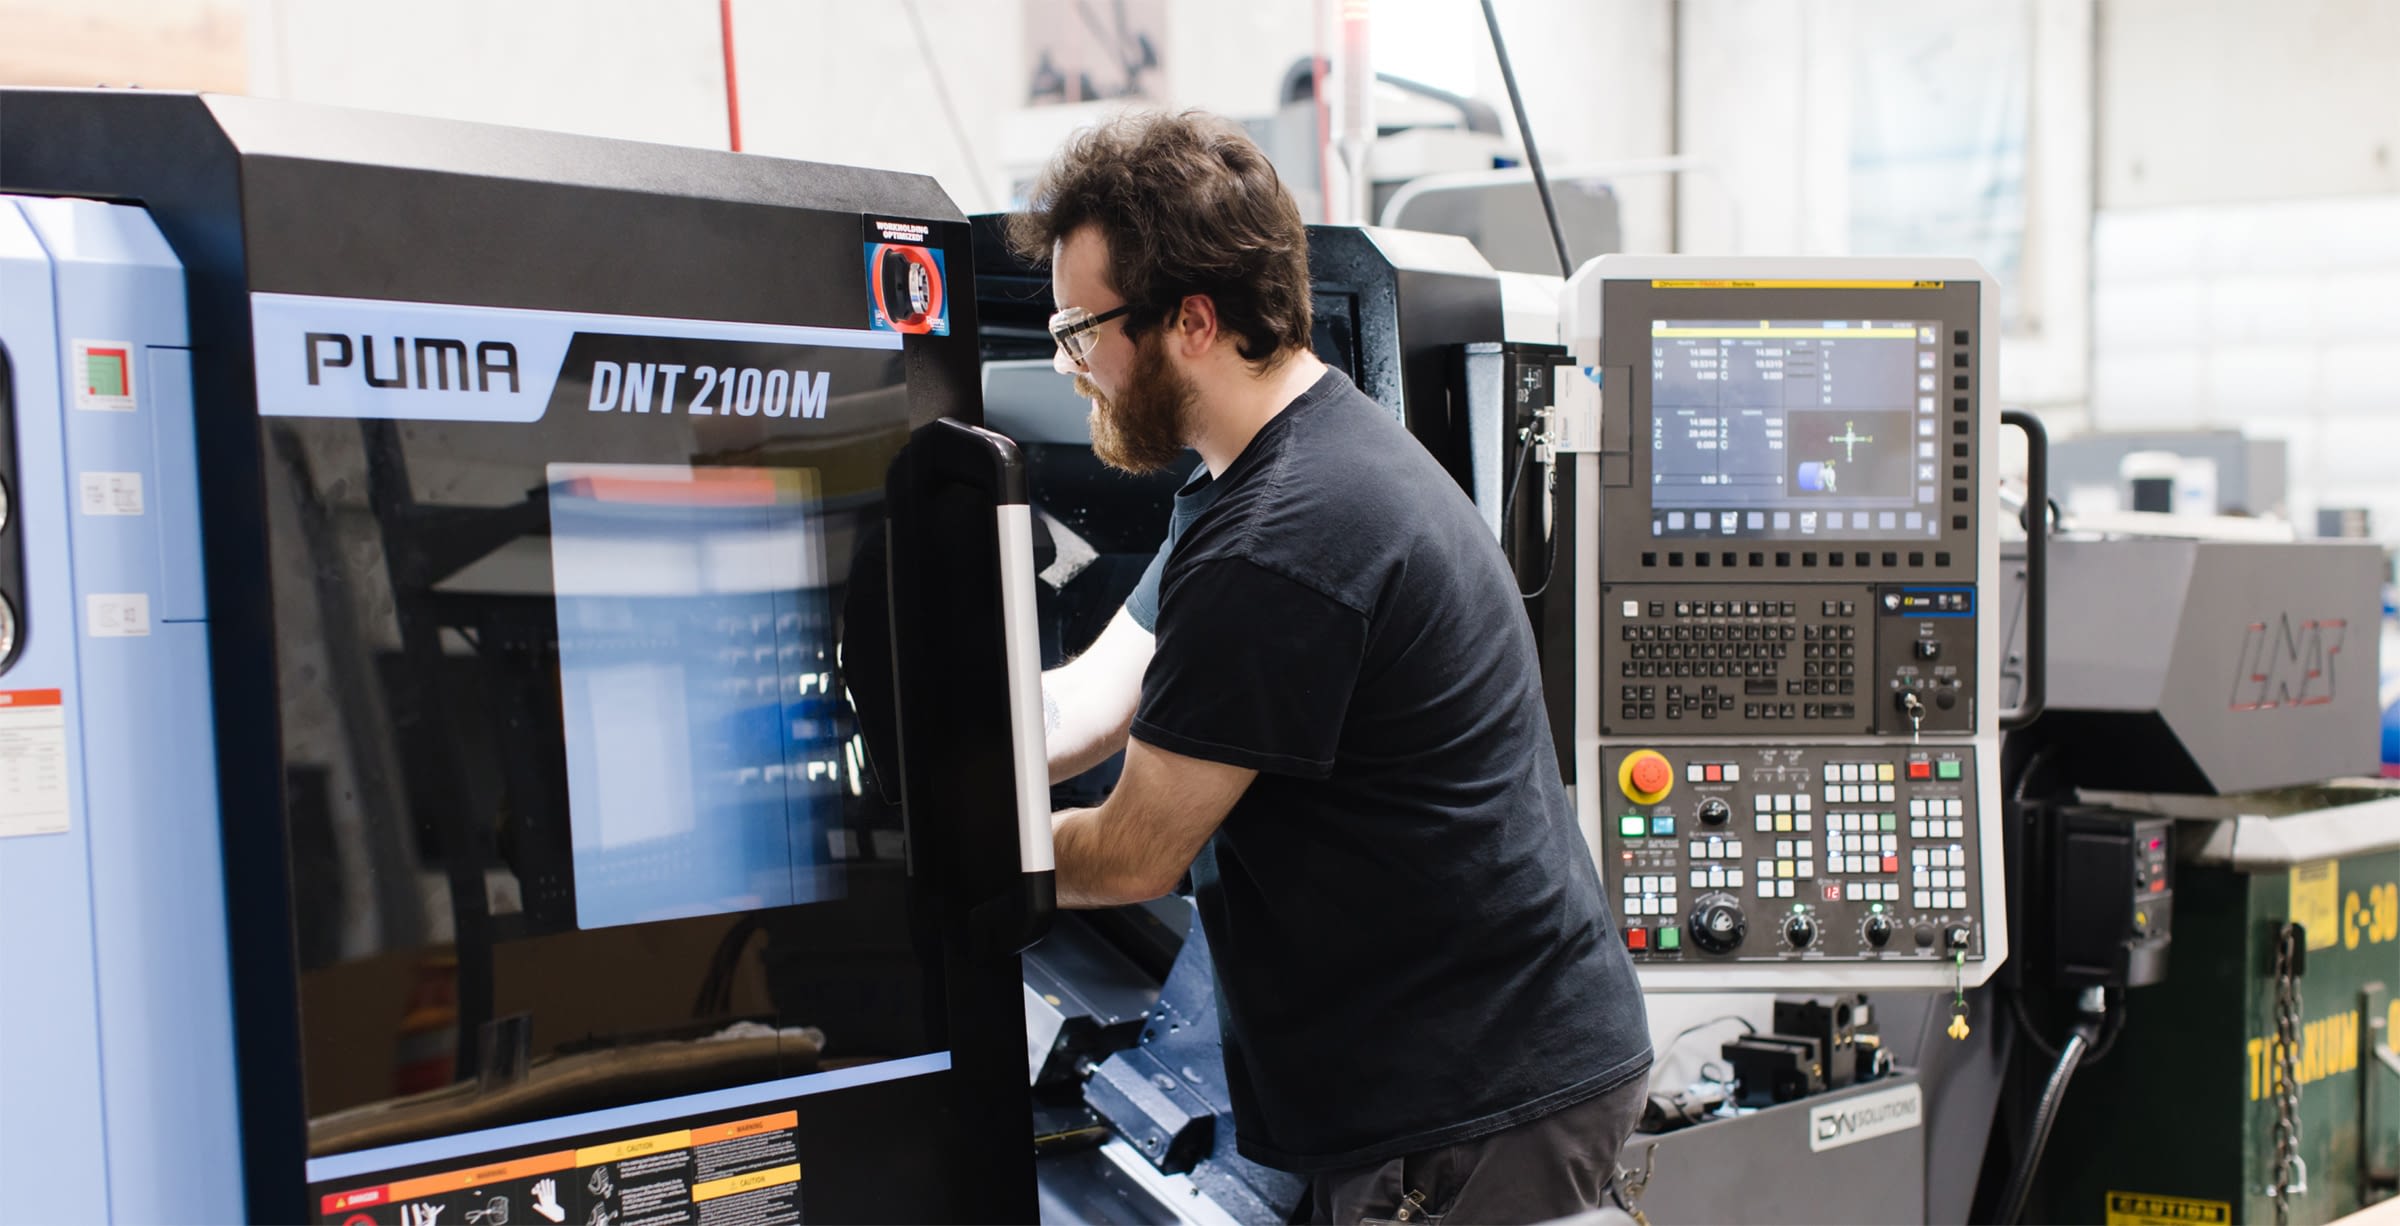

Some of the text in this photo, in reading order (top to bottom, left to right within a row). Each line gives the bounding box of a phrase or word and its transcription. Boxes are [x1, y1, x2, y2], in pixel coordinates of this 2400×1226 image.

[876, 221, 929, 235] WORKHOLDING
[305, 332, 520, 393] PUMA
[587, 360, 830, 419] DNT 2100M
[1826, 886, 1840, 899] 12
[2344, 882, 2399, 950] C-30
[1858, 1096, 1917, 1128] SOLUTIONS
[626, 1141, 655, 1153] CAUTION
[739, 1175, 767, 1188] CAUTION
[2118, 1198, 2218, 1222] CAUTION
